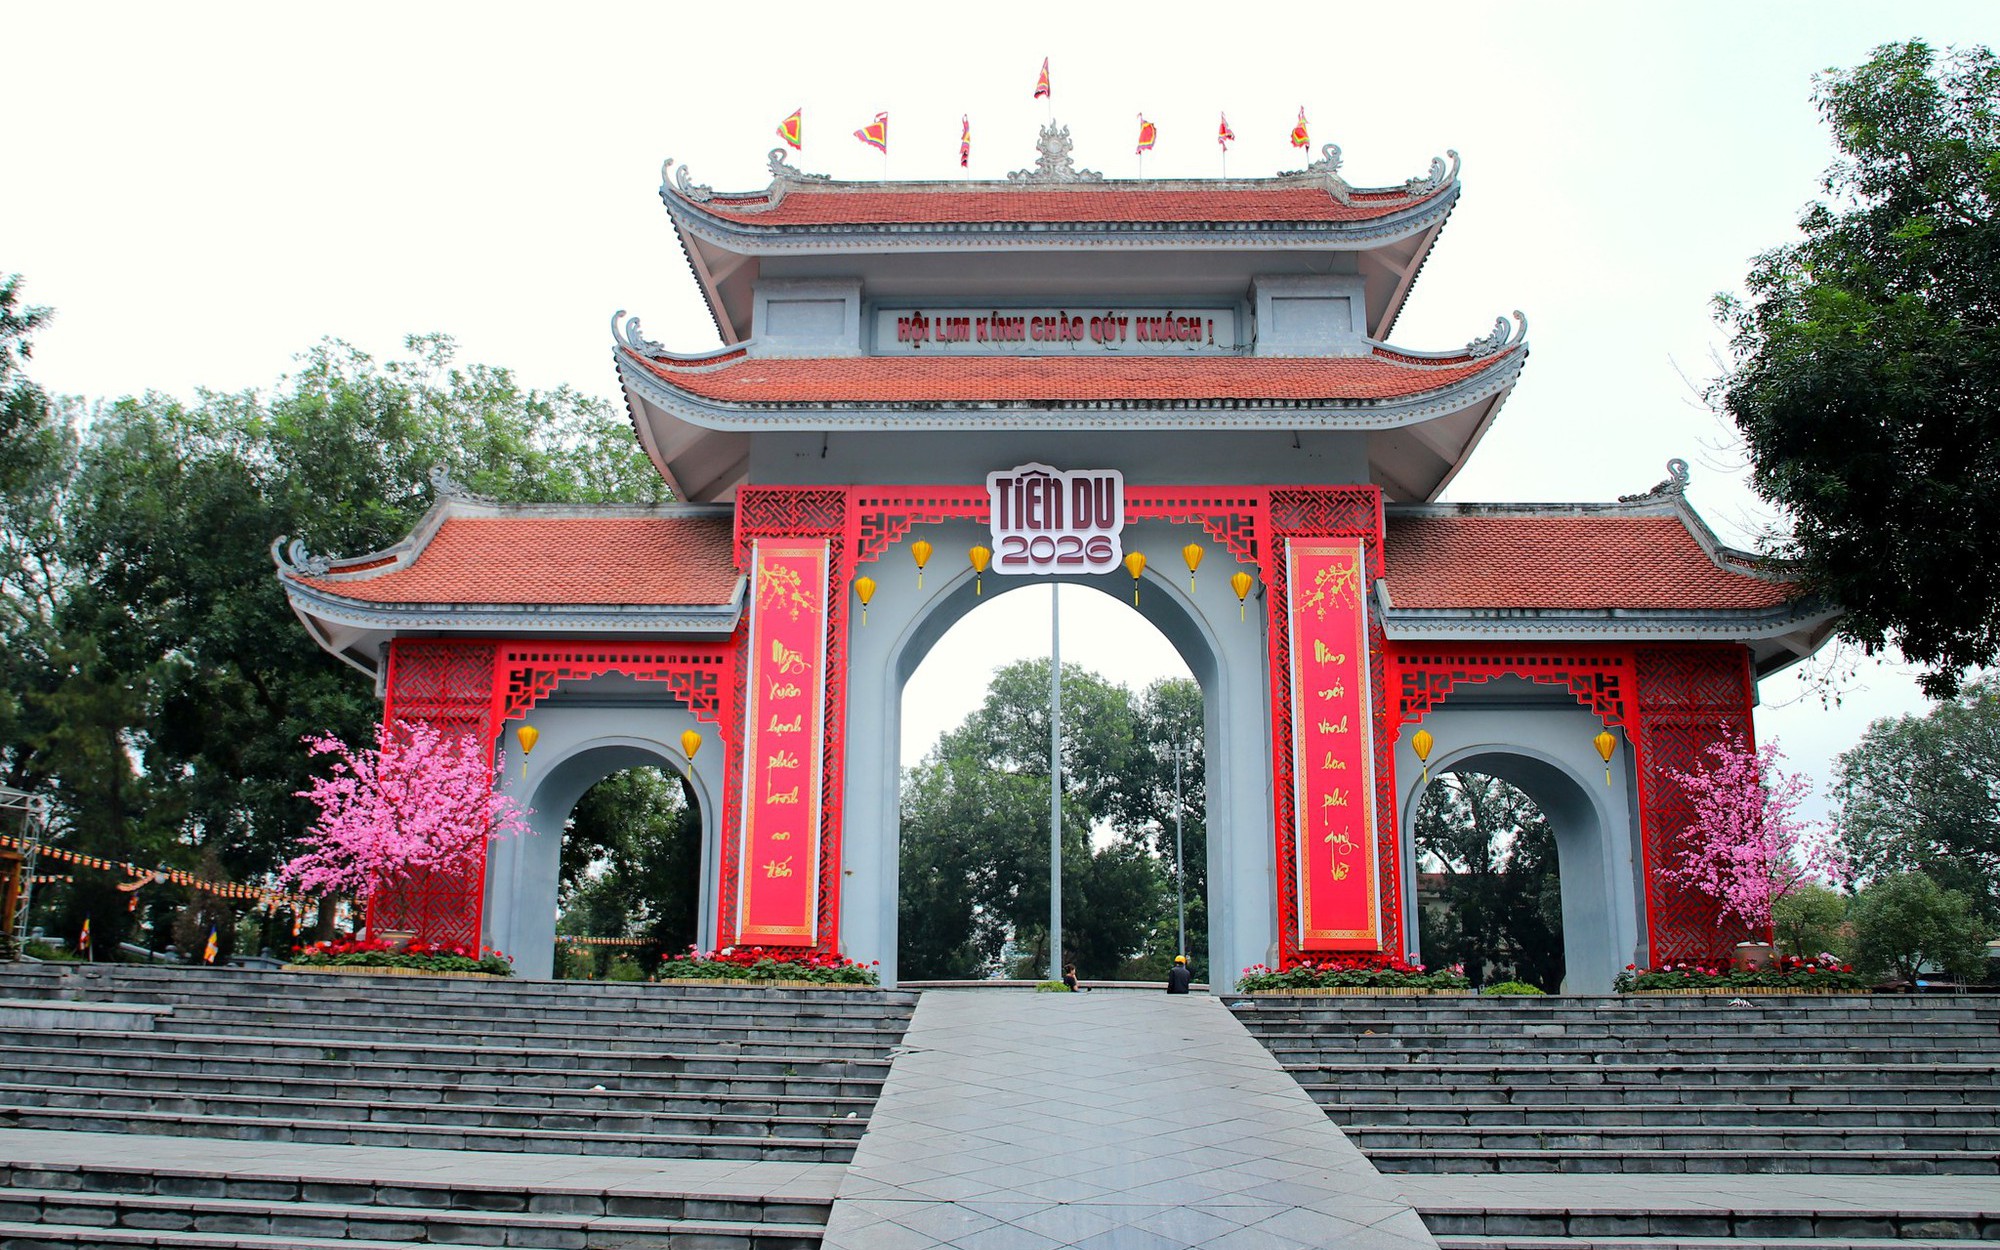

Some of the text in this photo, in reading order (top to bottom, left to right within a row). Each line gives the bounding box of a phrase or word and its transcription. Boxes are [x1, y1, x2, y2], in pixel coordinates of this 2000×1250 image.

[898, 311, 930, 348] HỘI
[936, 317, 971, 342] LIM
[976, 311, 1025, 342] KÍNH
[1031, 311, 1084, 342] CHÀO
[1136, 311, 1202, 342] KHÁCH
[1072, 477, 1115, 529] DU
[1001, 535, 1114, 565] 2026
[766, 714, 802, 737] hạnh
[766, 750, 800, 784] phúc
[1321, 751, 1346, 769] hoa
[1321, 787, 1349, 826] phú
[772, 831, 790, 840] an
